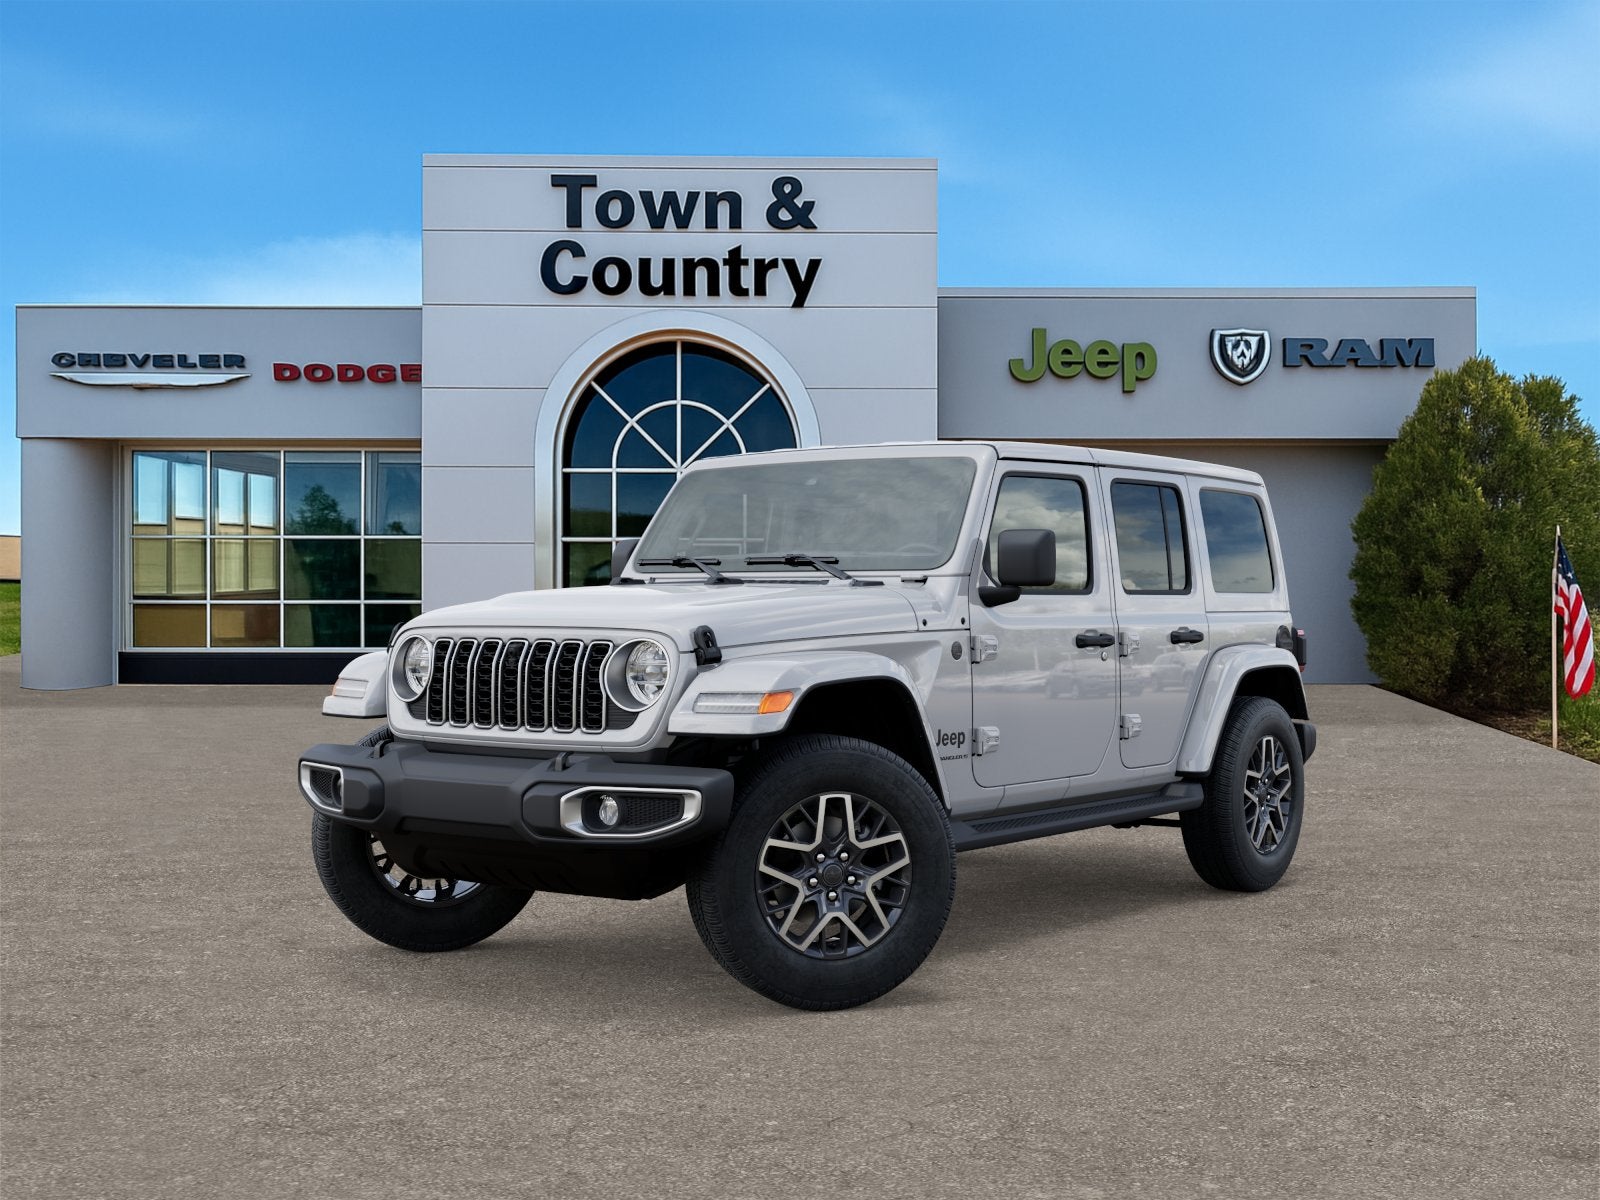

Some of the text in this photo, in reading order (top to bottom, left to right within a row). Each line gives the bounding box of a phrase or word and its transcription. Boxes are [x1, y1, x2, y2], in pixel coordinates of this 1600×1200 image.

[550, 174, 818, 230] Town &
[540, 239, 823, 308] Country
[273, 362, 422, 383] DODGE
[1008, 327, 1158, 393] Jeep
[1282, 337, 1436, 367] RAM
[936, 728, 966, 748] Jeep
